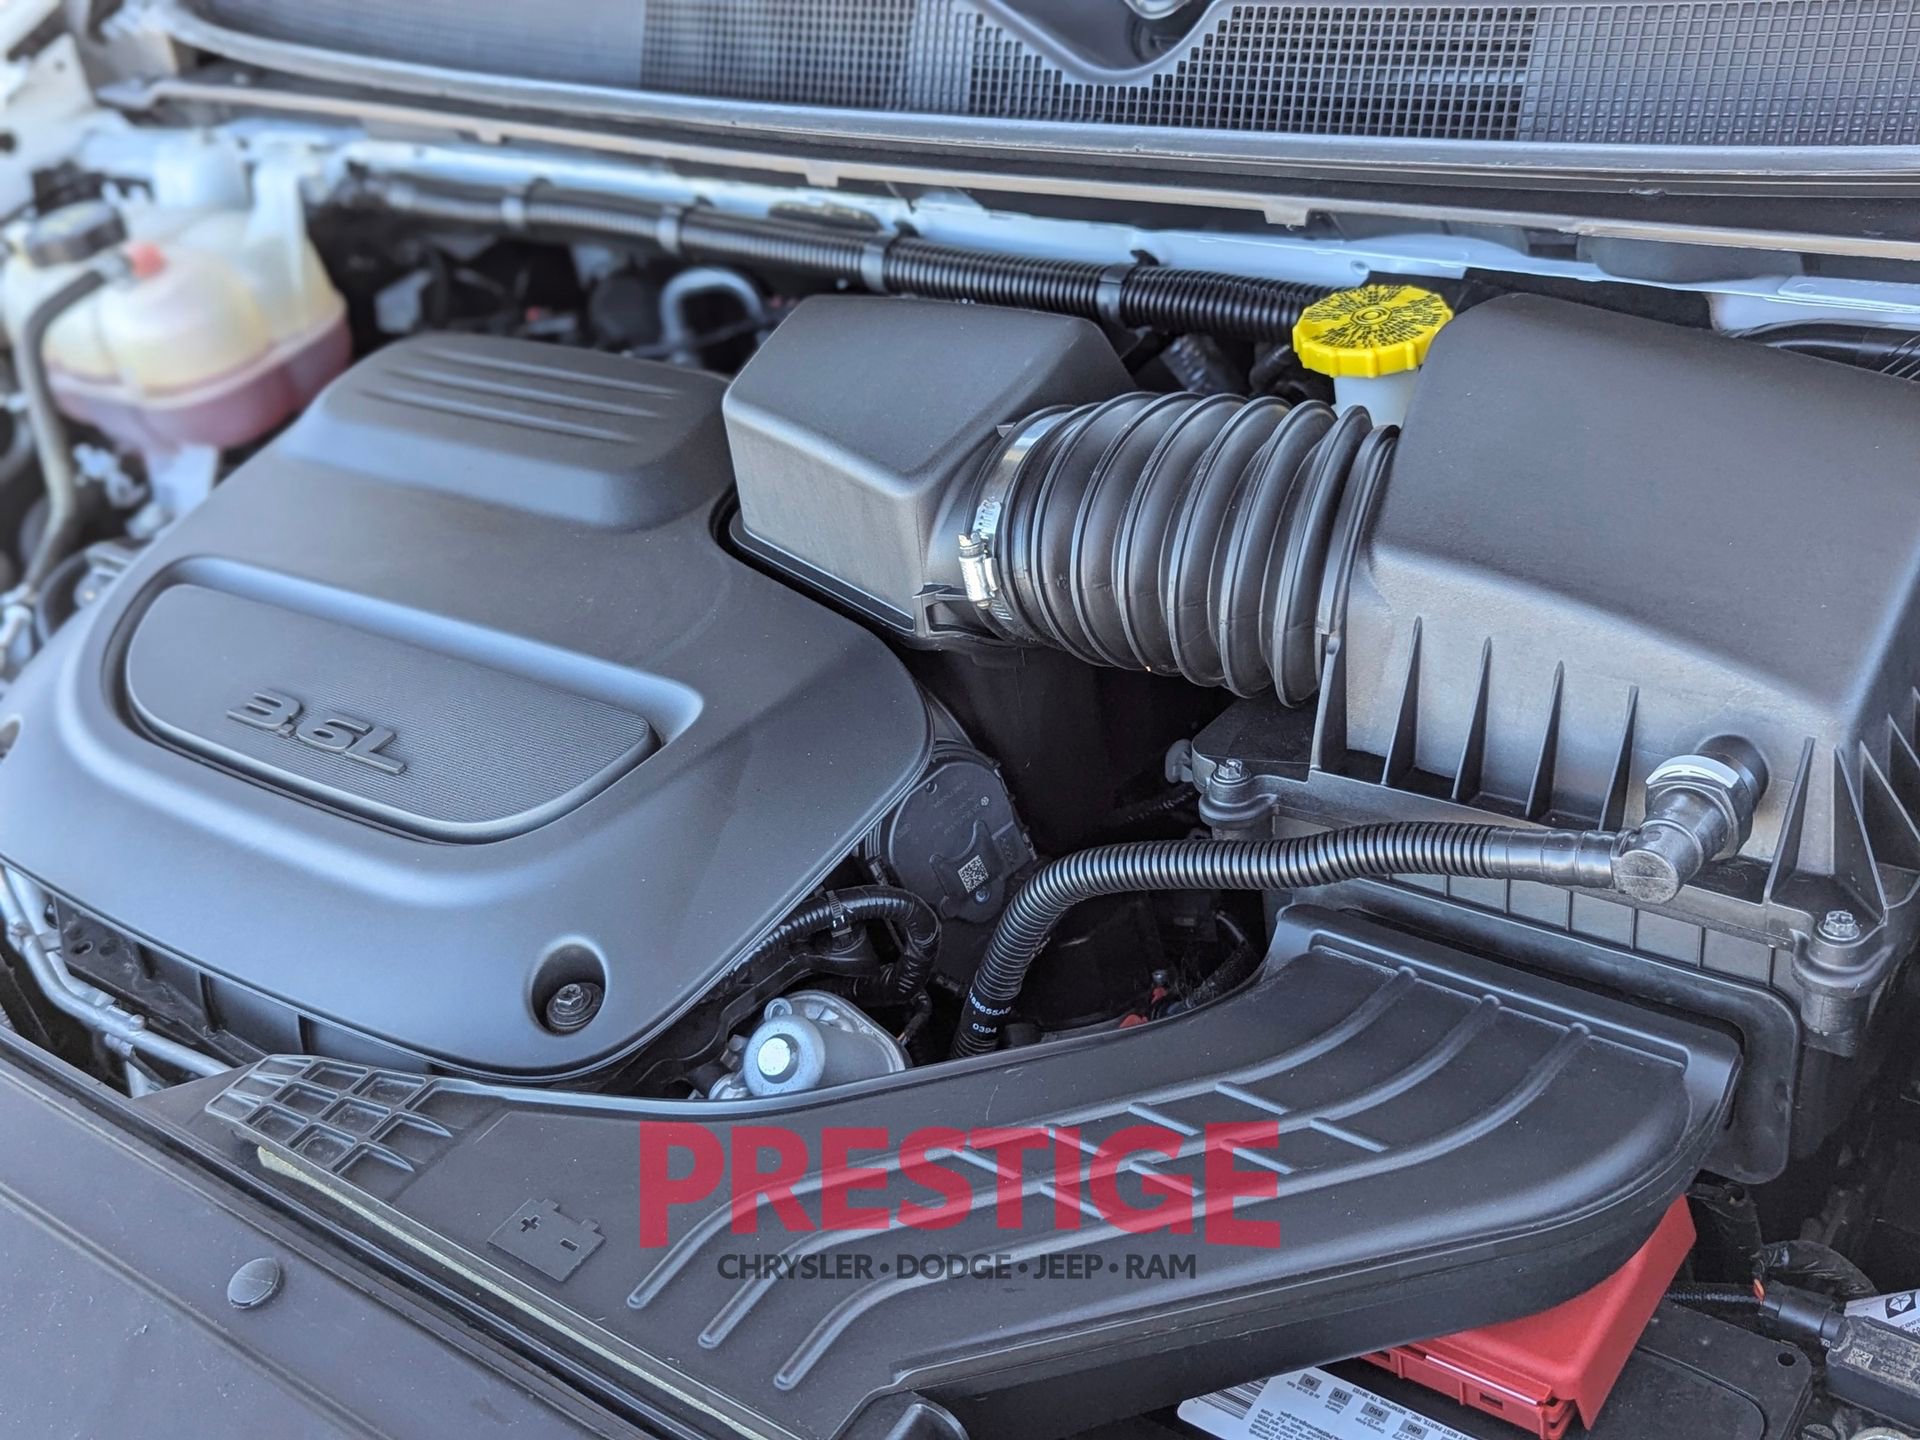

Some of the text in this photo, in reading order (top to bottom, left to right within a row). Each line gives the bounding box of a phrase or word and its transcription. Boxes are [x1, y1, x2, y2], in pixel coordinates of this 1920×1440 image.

[227, 691, 408, 775] 3.6L
[1334, 1391, 1347, 1400] 110
[1369, 1406, 1384, 1417] 850
[1443, 1426, 1459, 1438] BEST
